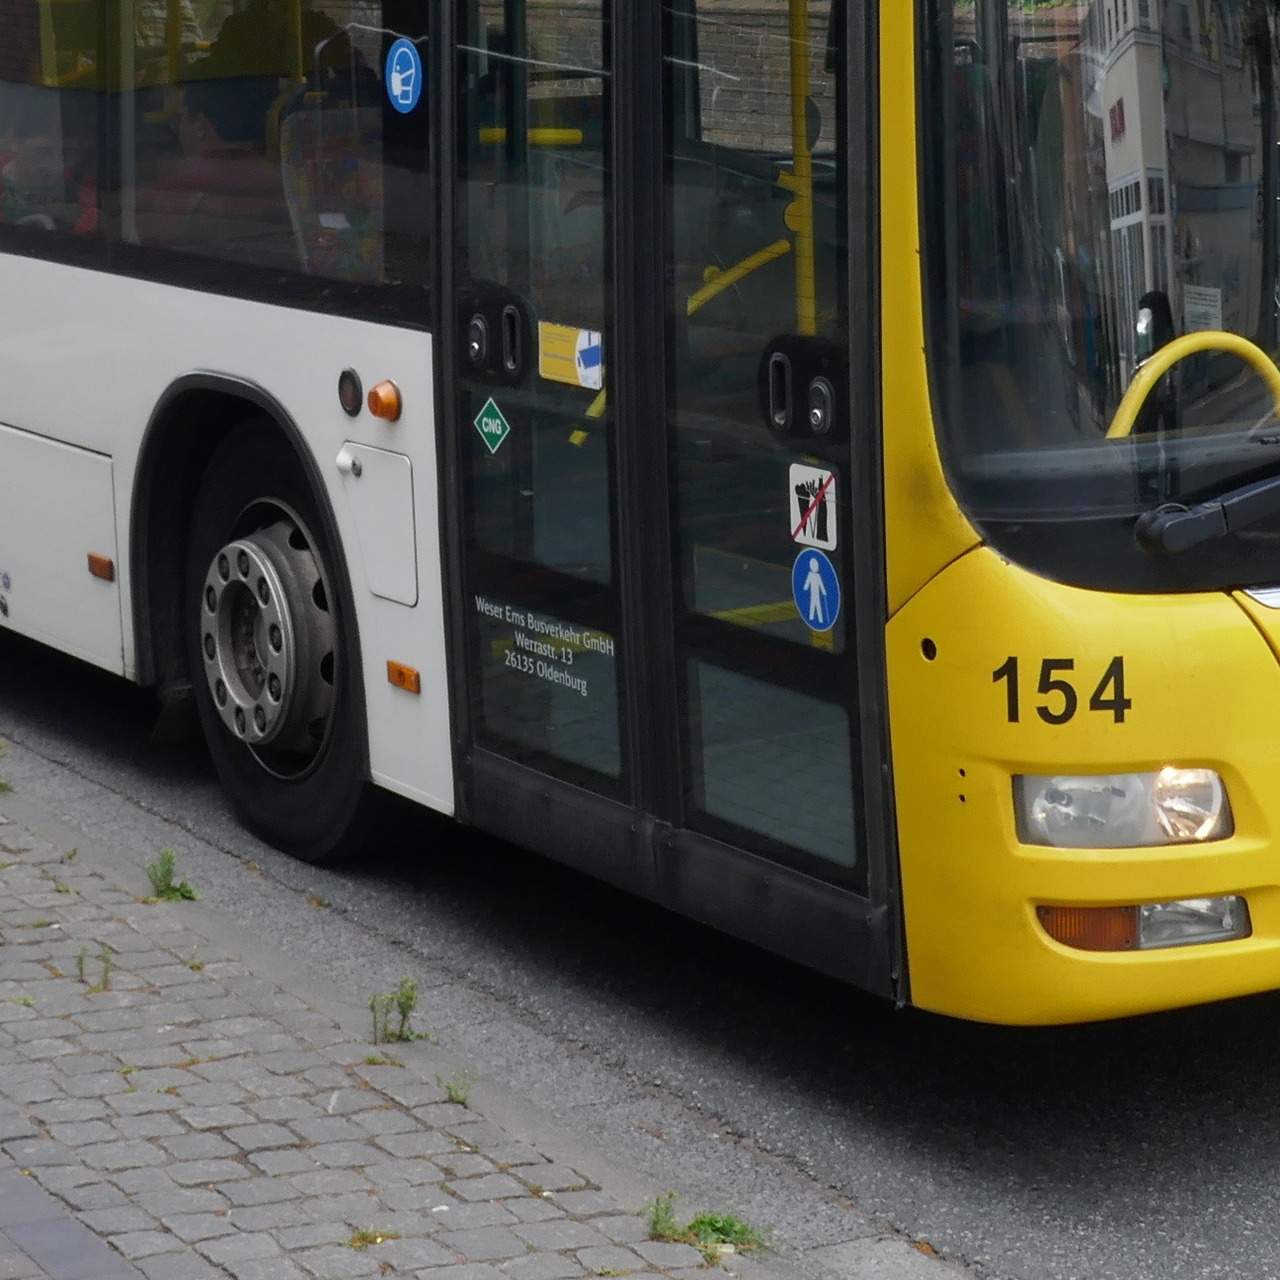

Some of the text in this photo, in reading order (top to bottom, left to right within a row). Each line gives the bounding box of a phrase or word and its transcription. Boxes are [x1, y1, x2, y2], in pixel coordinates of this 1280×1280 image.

[482, 417, 502, 435] CNG
[475, 595, 614, 656] Weser Ems Busverkehr GmbH
[515, 631, 573, 665] Werrastr. 13
[505, 650, 587, 696] 26135 Oldenburg
[992, 656, 1132, 725] 154
